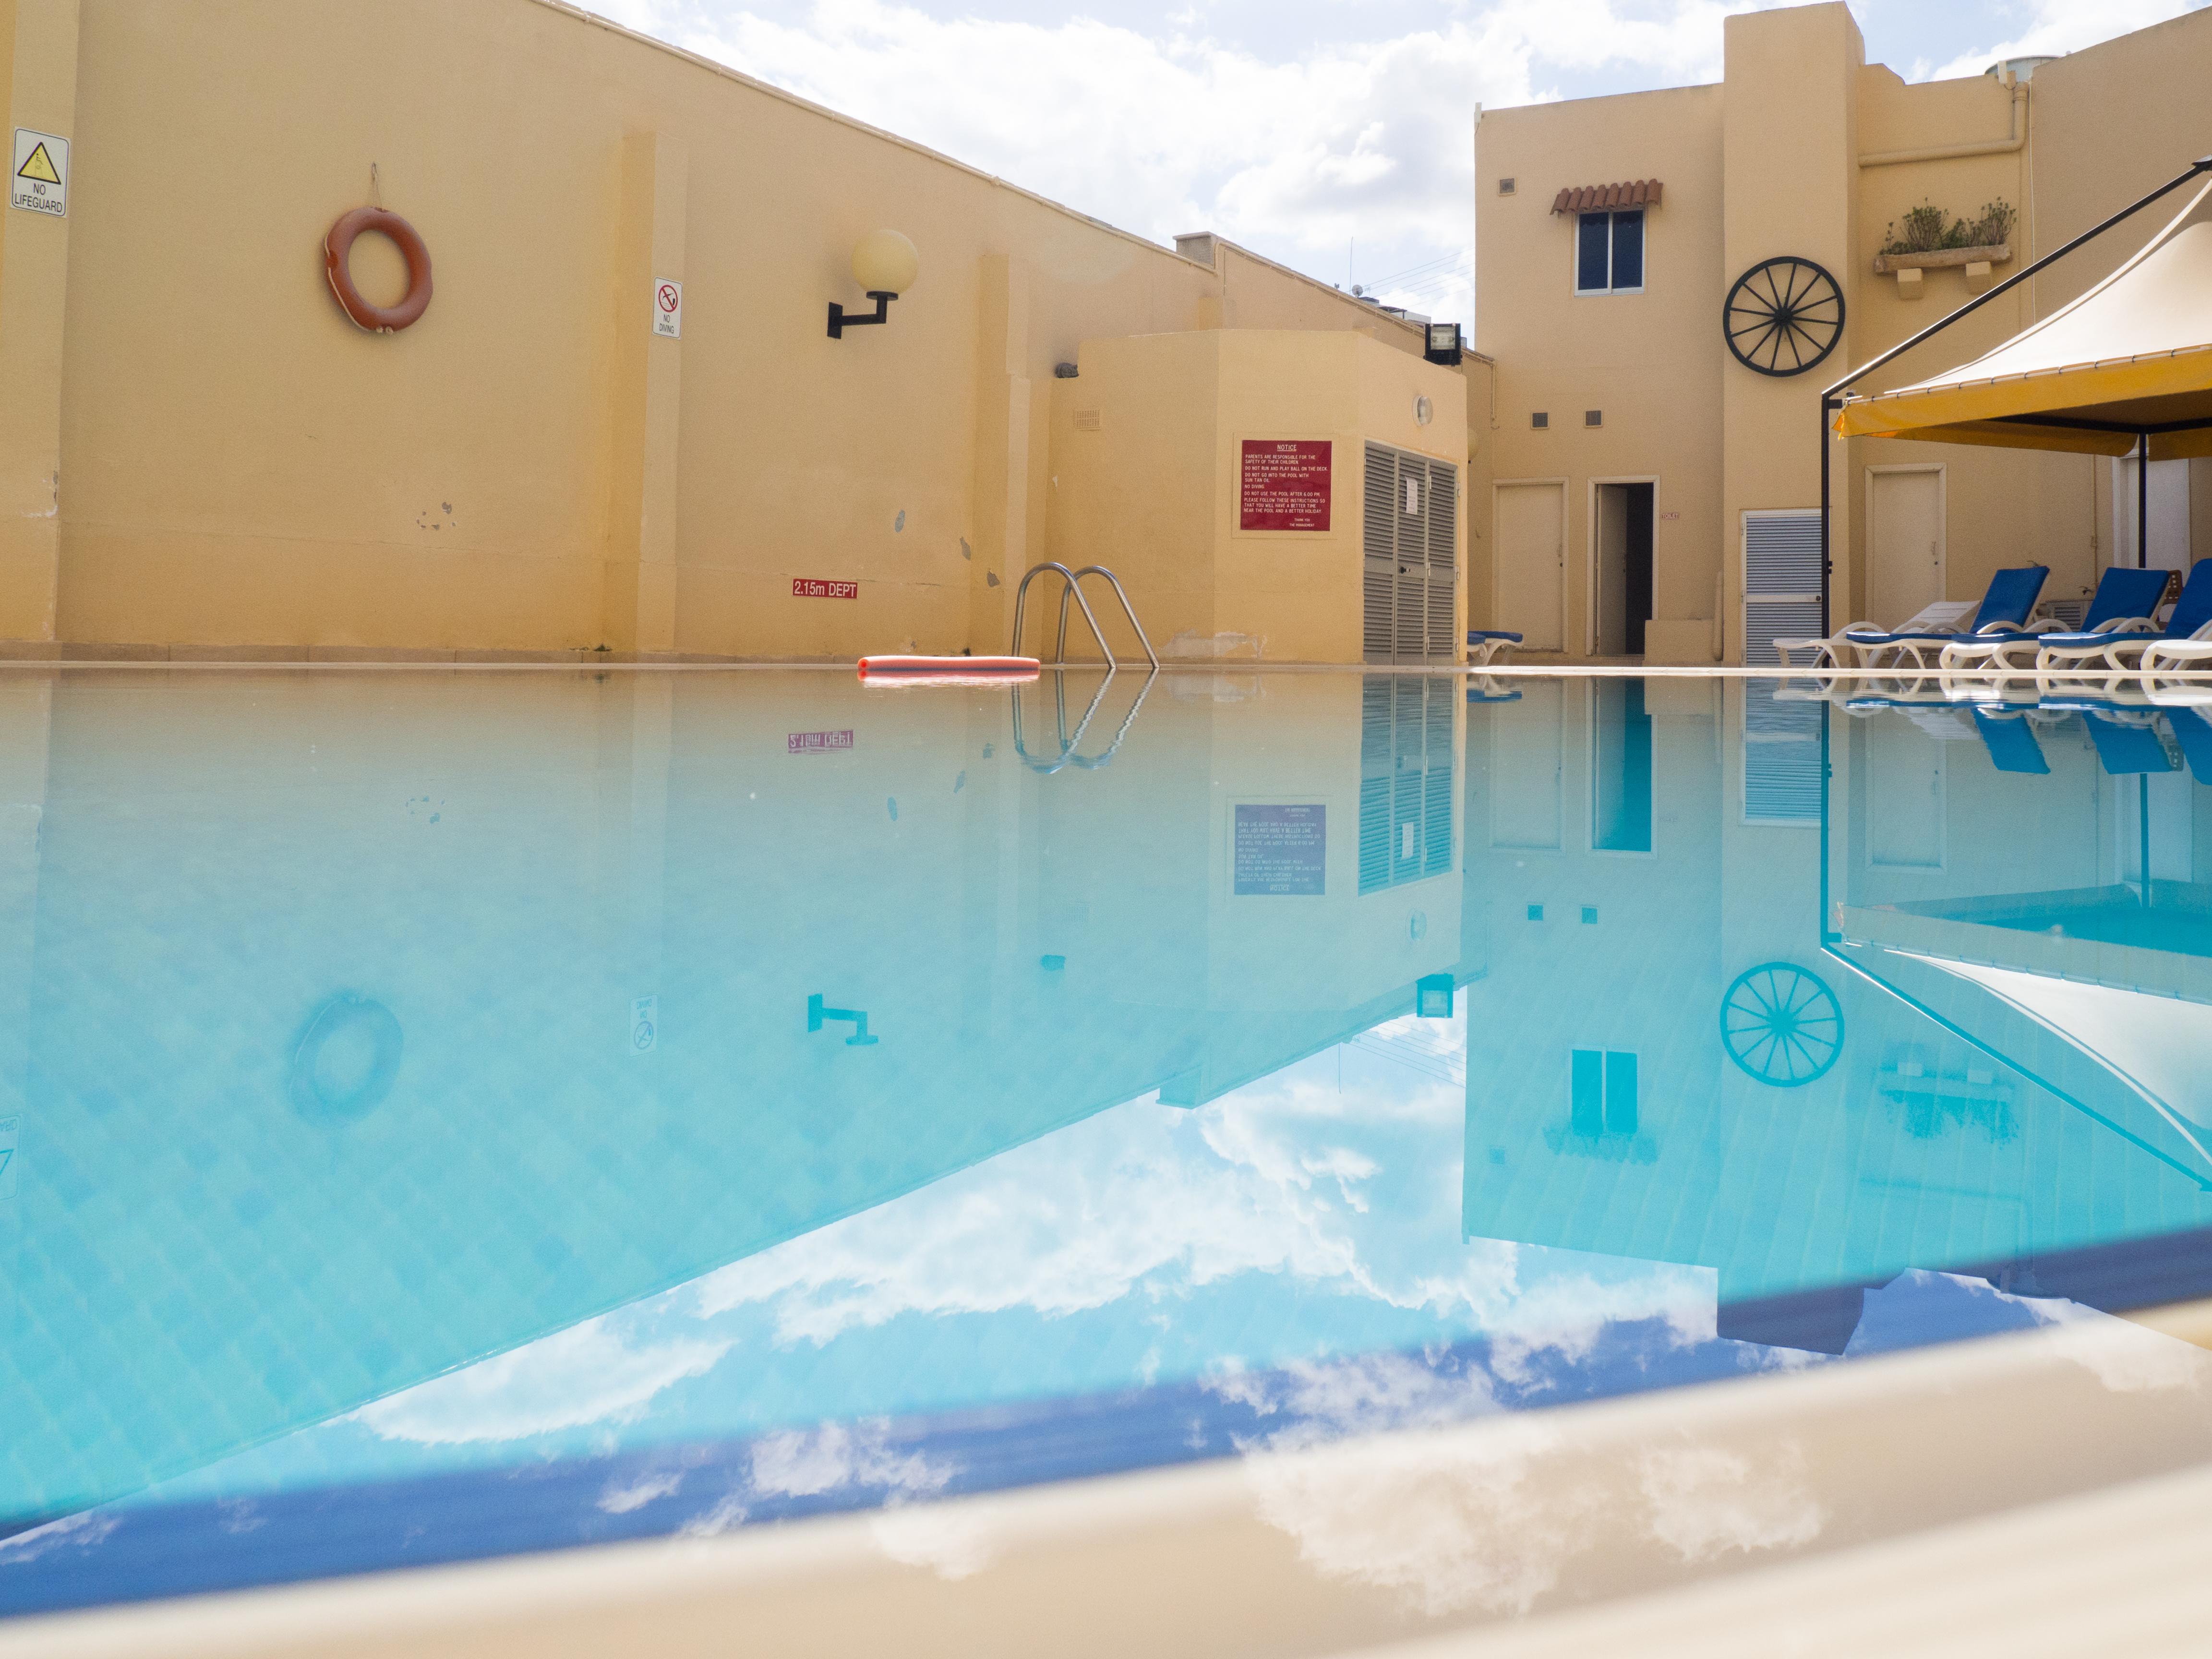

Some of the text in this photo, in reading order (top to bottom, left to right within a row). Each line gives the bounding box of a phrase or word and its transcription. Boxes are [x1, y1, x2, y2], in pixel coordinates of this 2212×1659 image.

[34, 183, 46, 195] NO
[15, 193, 62, 212] LIFEGUARD
[663, 314, 670, 323] NO
[660, 324, 674, 334] DIVING
[794, 581, 856, 597] 2.15m DEPT
